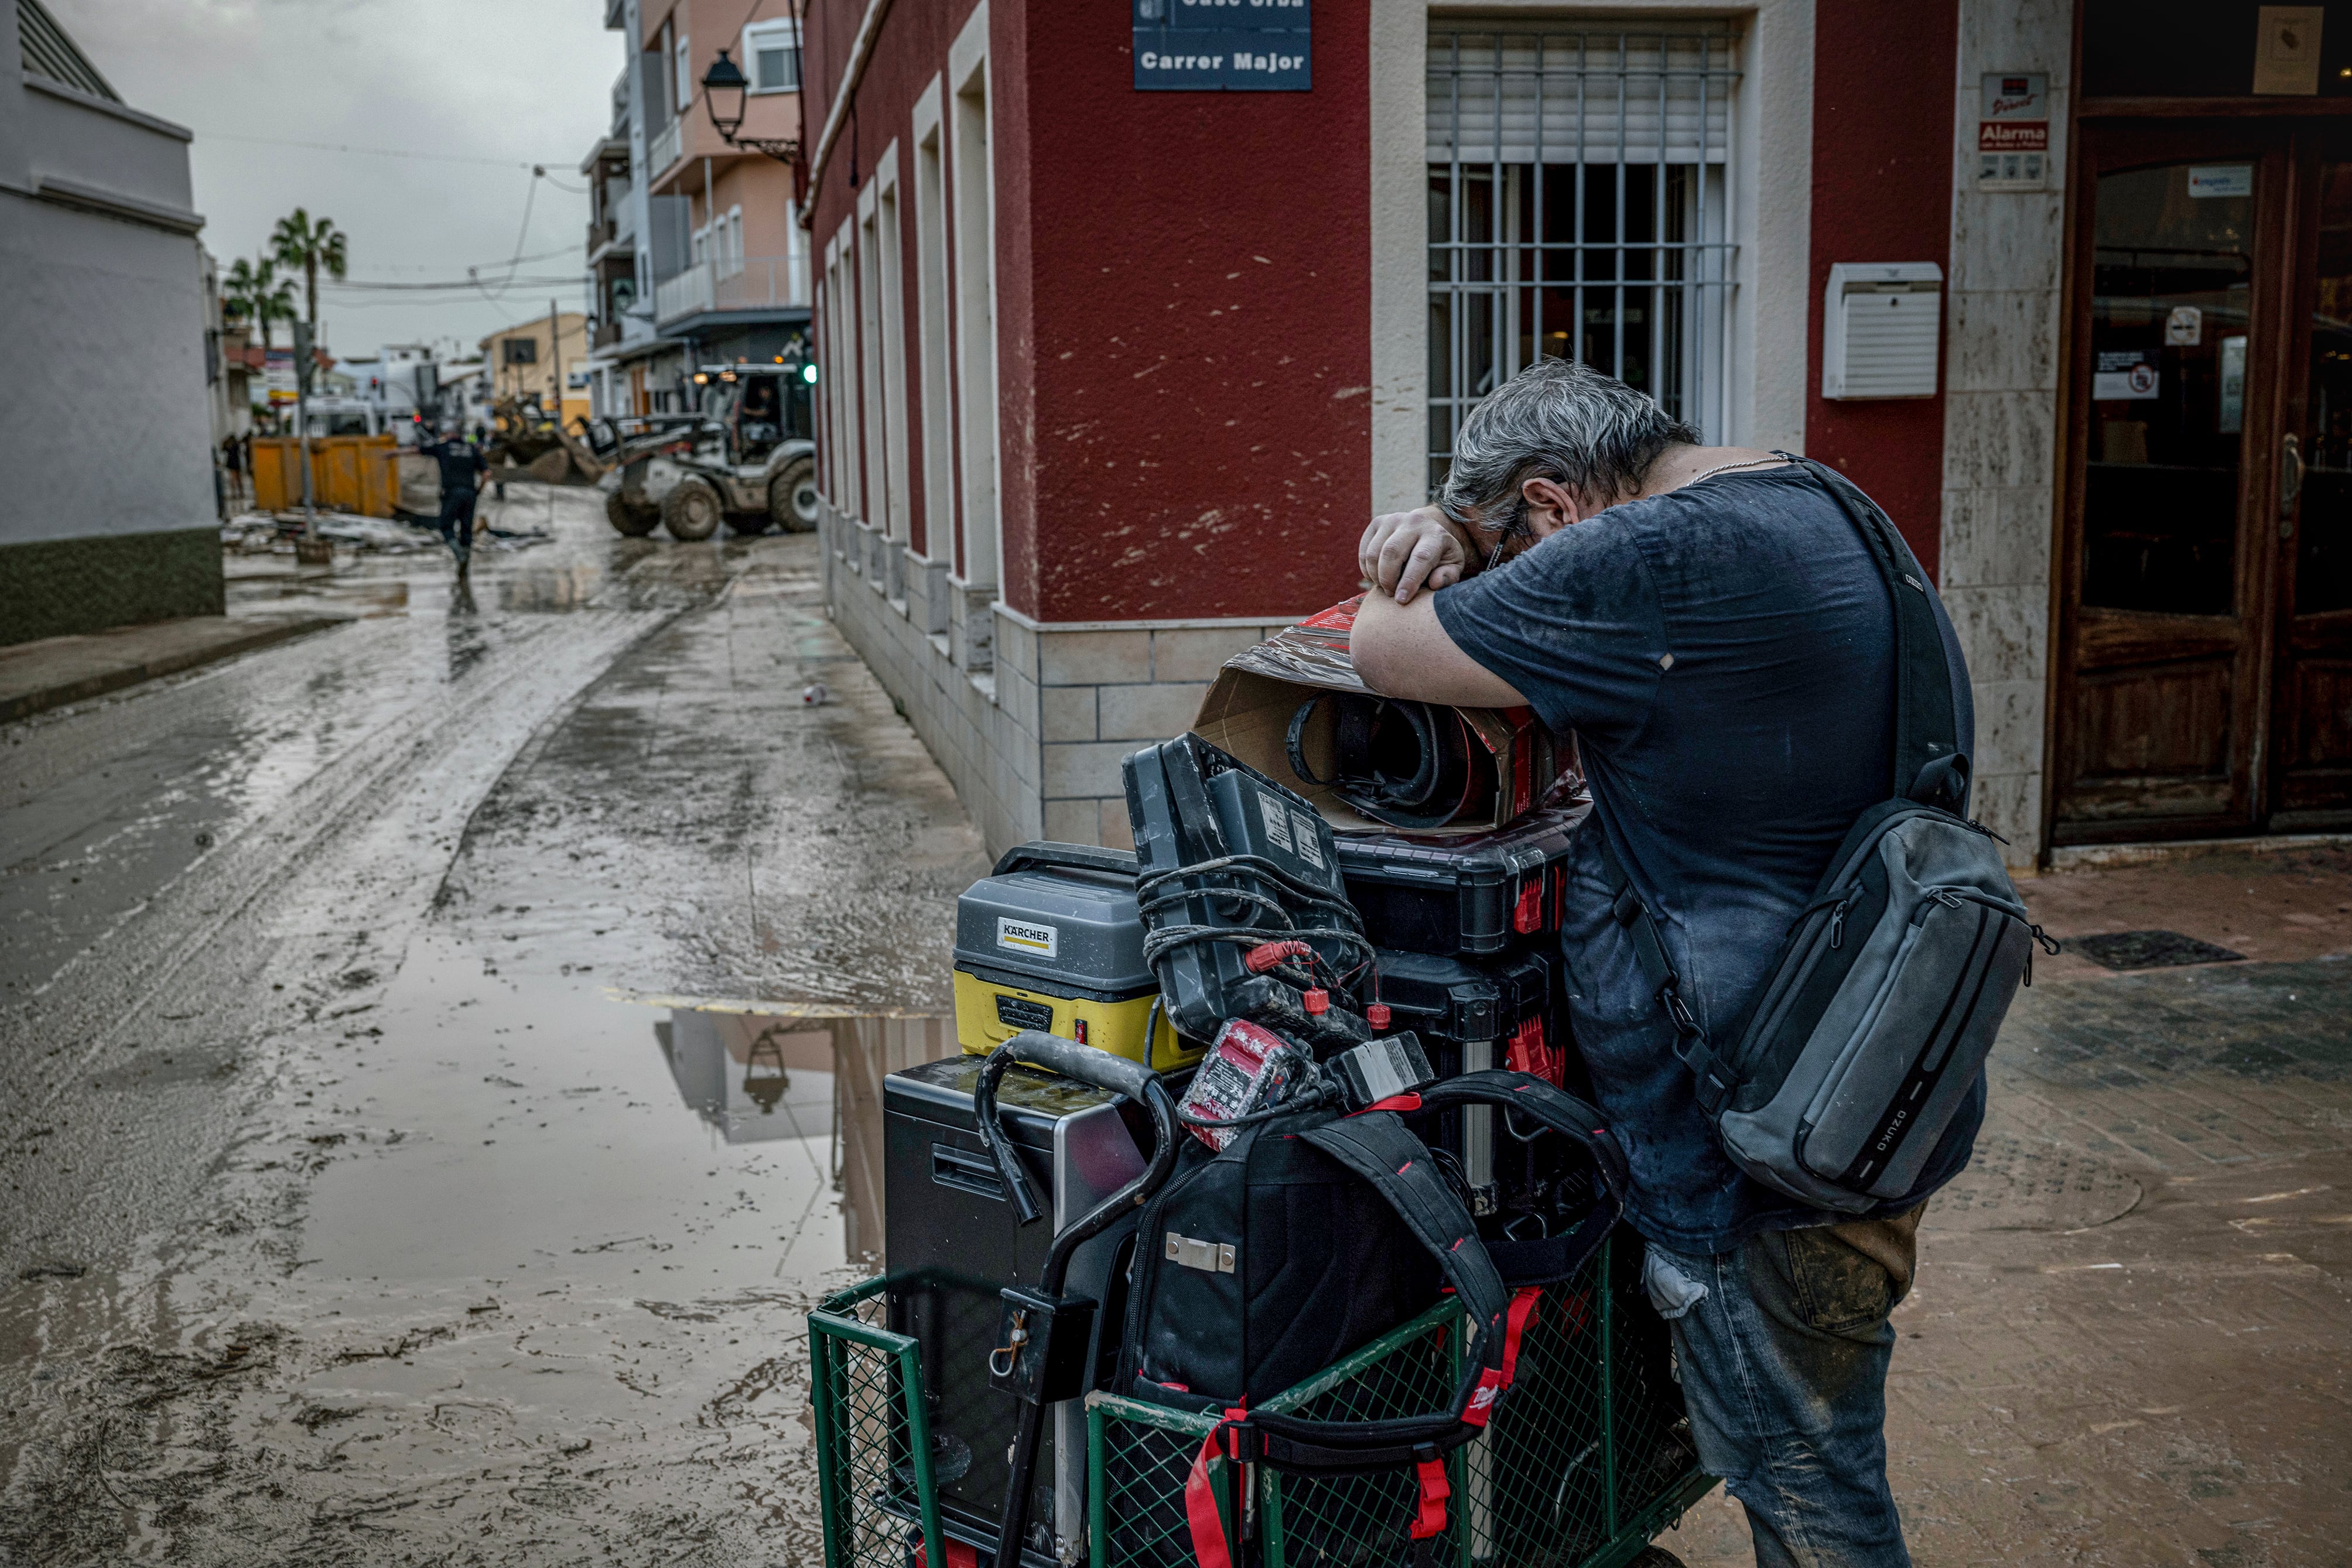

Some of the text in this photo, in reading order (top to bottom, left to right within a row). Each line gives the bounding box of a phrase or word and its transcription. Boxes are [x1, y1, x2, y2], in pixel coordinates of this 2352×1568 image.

[1141, 52, 1305, 73] Carrer Major
[1981, 124, 2046, 141] Alarma
[1004, 924, 1049, 942] KÄRCHER
[1876, 1110, 1907, 1151] OZUKO
